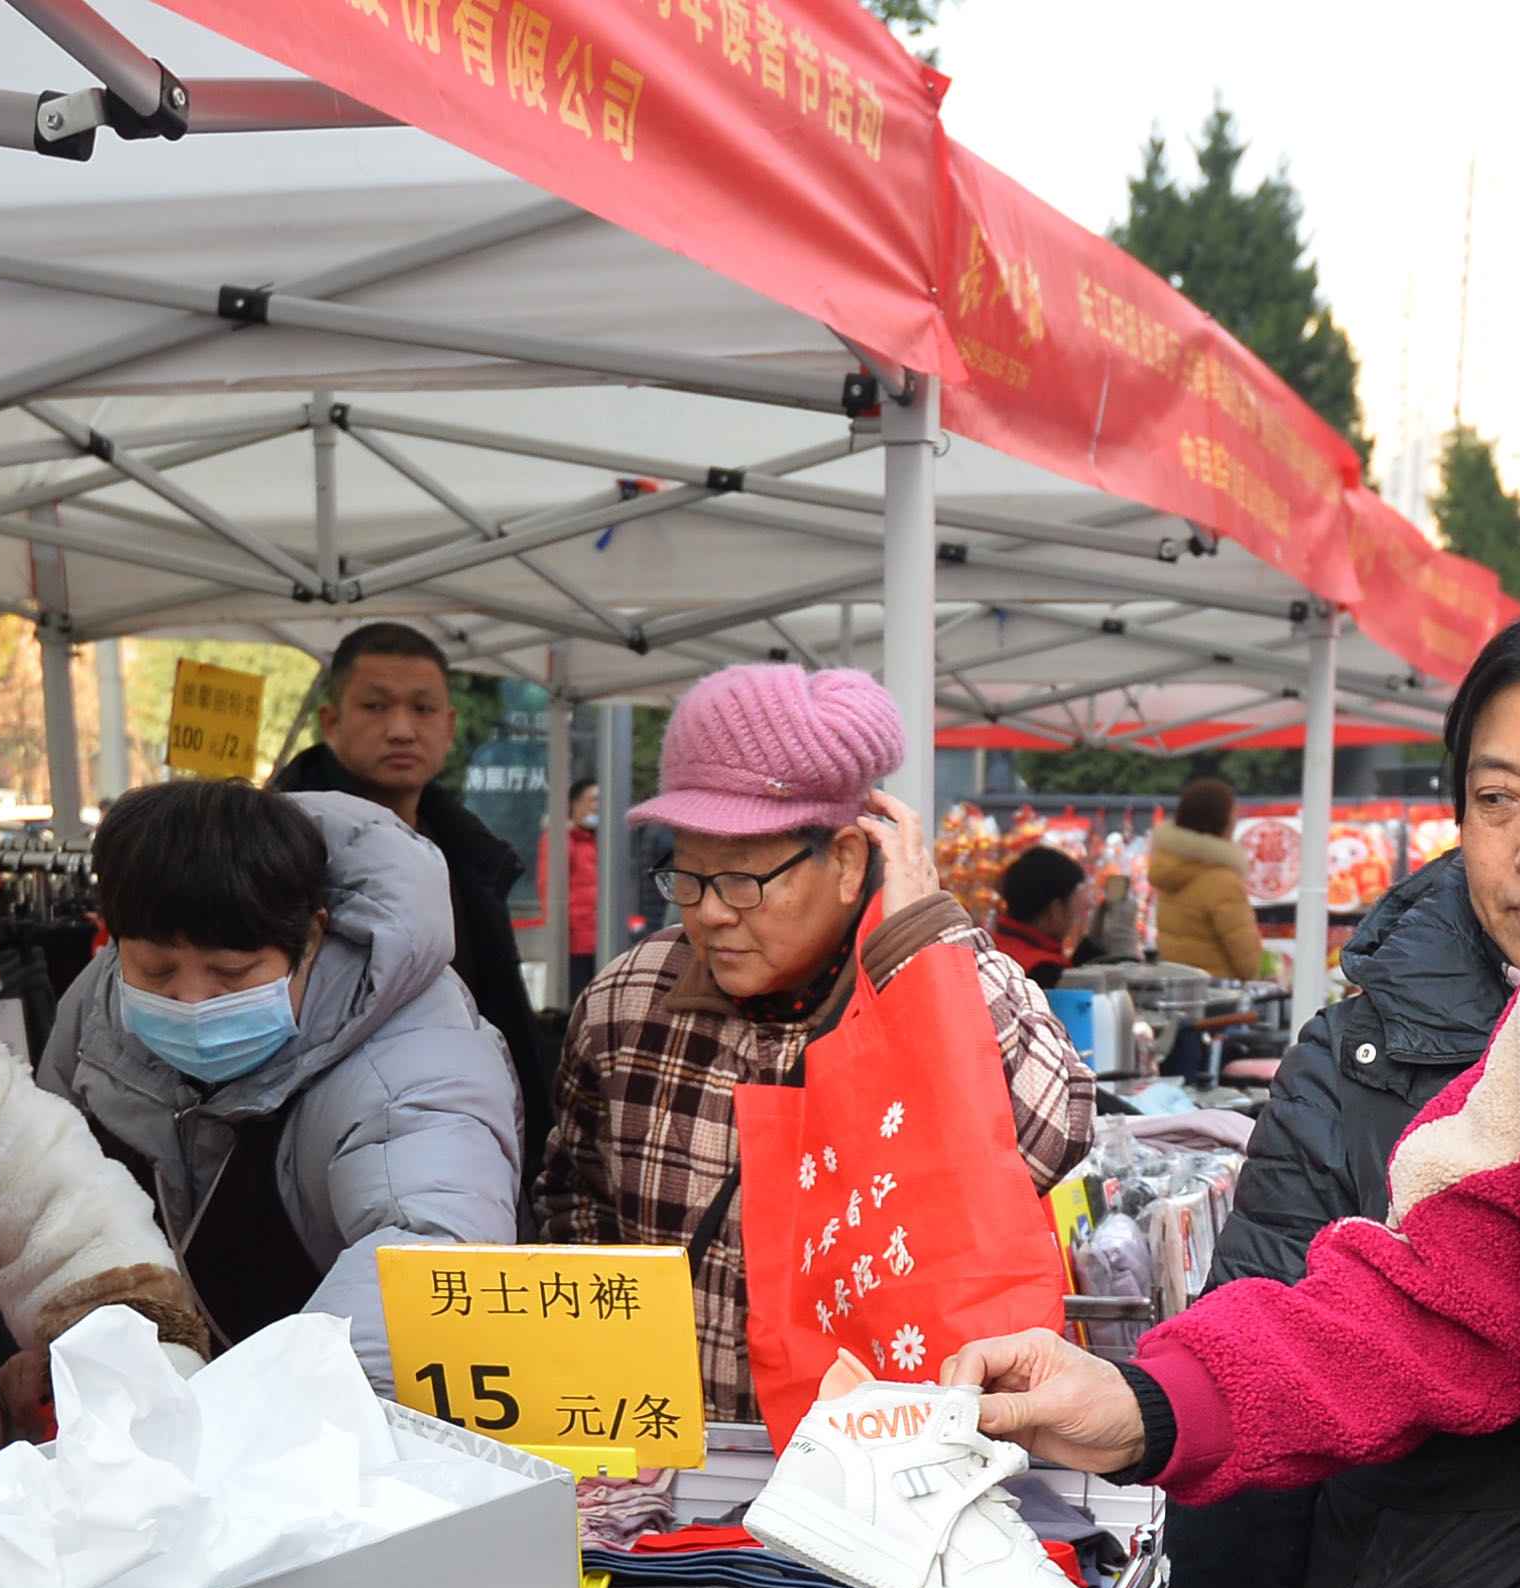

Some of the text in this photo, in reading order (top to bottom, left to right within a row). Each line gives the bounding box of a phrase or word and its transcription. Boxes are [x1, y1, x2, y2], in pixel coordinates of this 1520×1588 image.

[344, 0, 645, 162] 份有限公司
[430, 1269, 642, 1321] 男士内裤
[415, 1362, 682, 1441] 15 元/条
